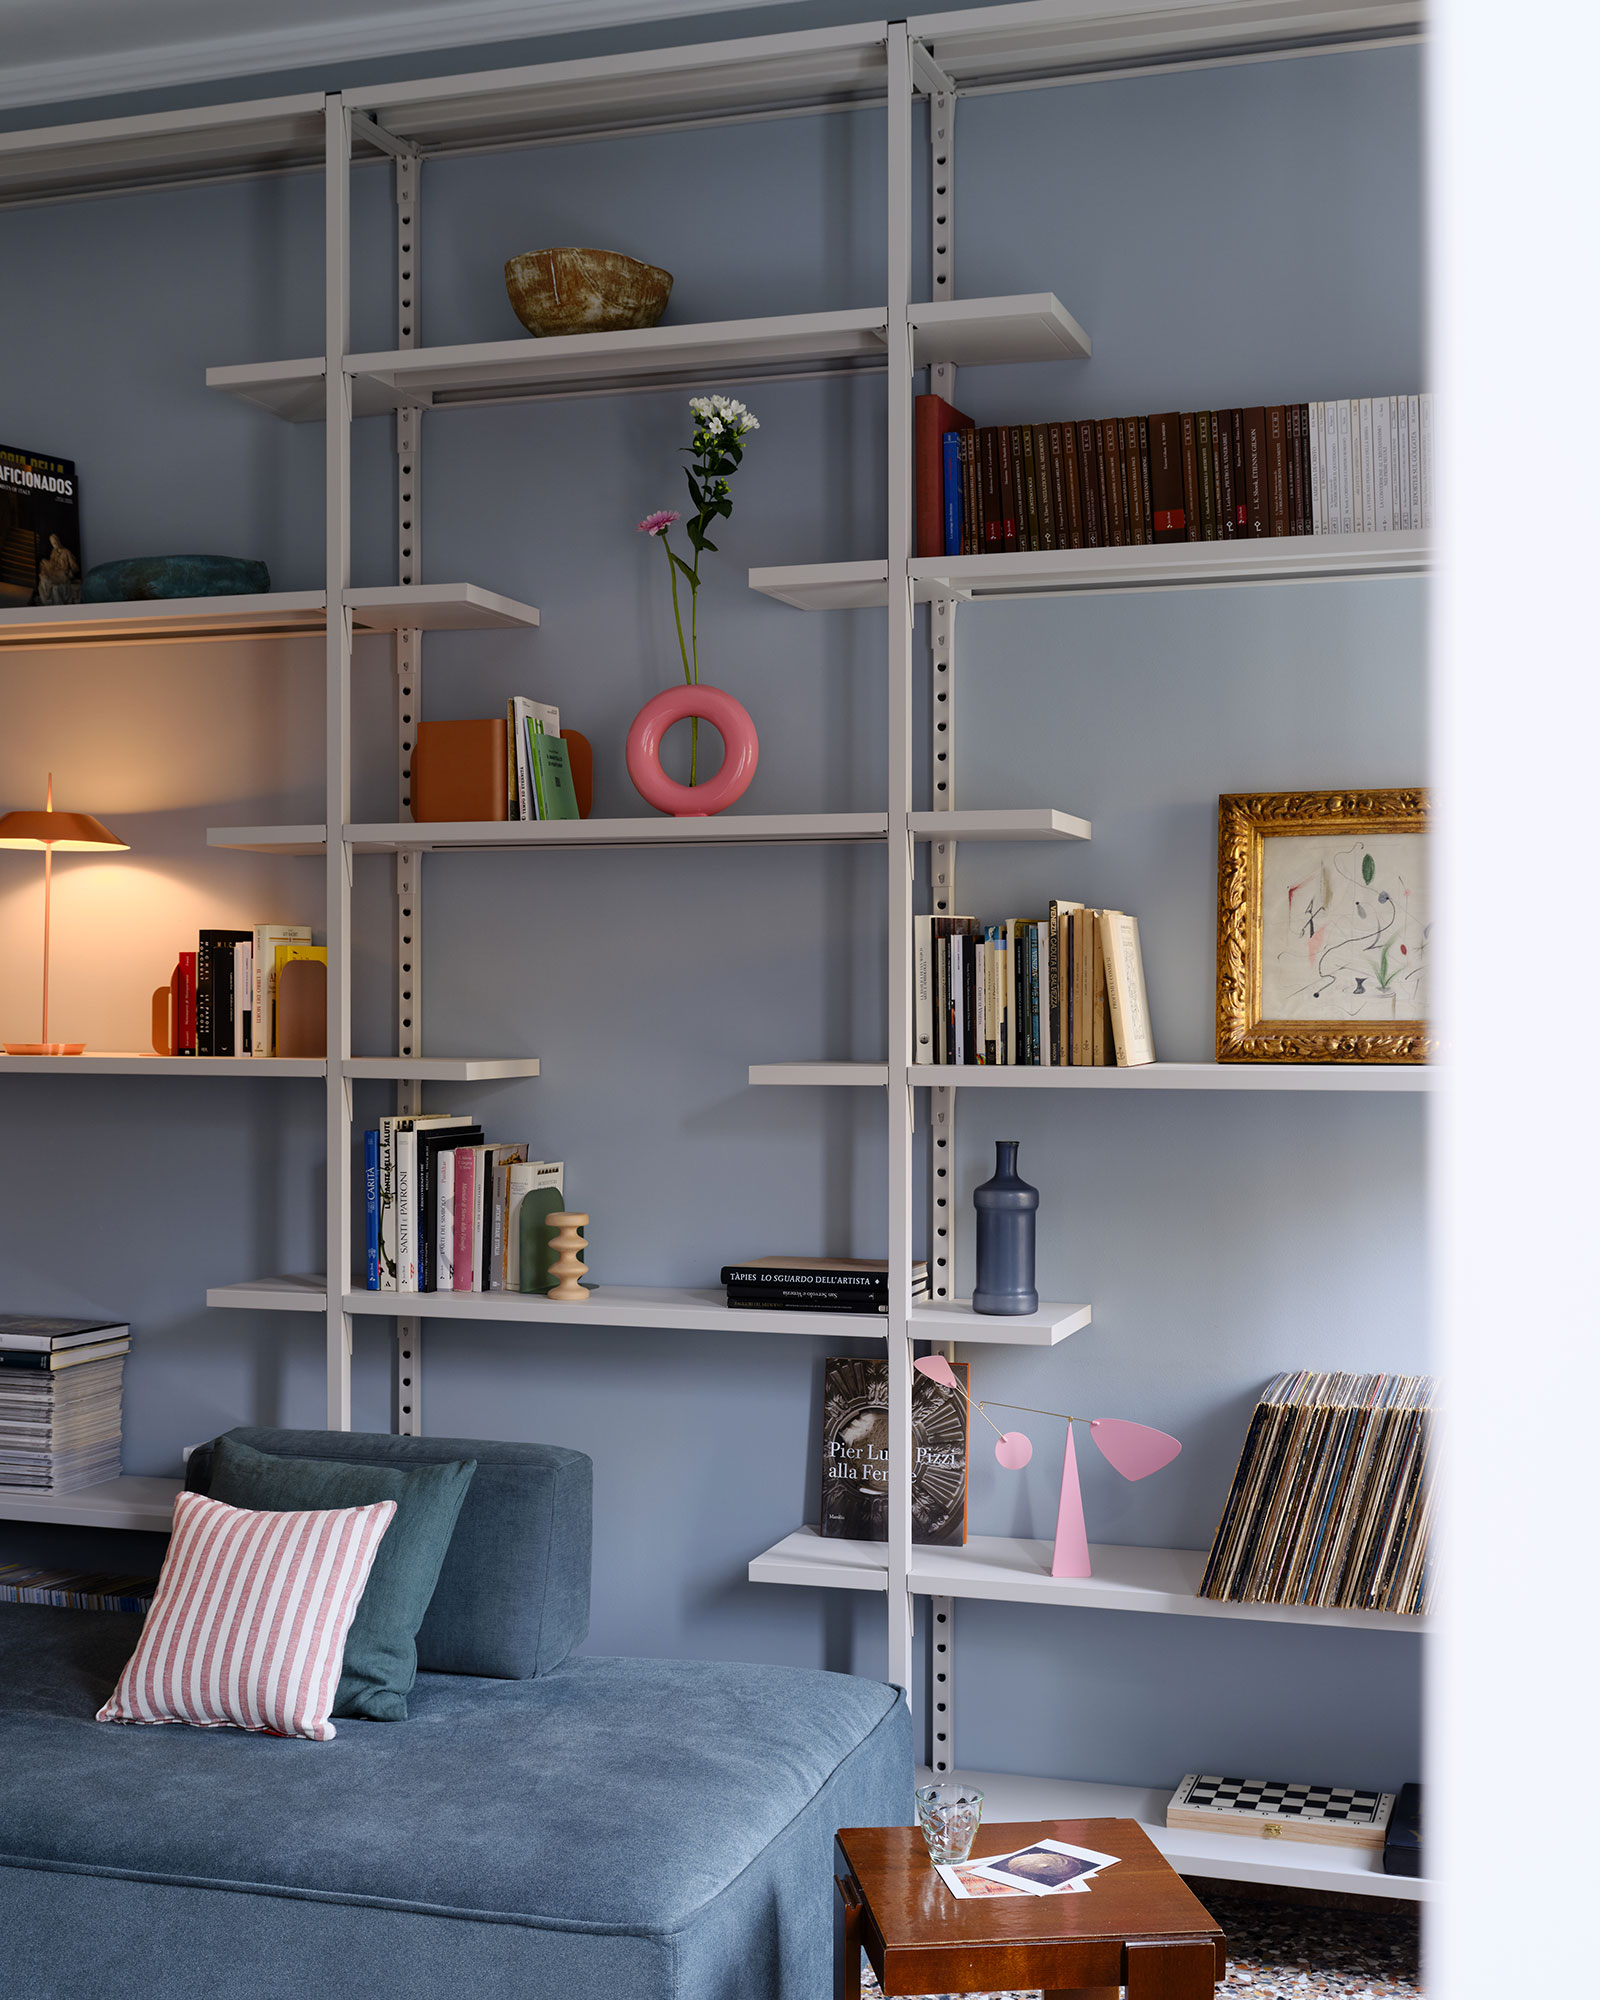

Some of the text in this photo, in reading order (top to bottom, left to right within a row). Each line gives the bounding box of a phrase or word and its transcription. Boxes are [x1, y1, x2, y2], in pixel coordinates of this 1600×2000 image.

[1249, 428, 1257, 450] GILSON
[365, 1167, 375, 1201] CARITÀ
[400, 1171, 408, 1215] PATRONI
[385, 1200, 391, 1209] LE
[730, 1273, 757, 1281] TÀPIES
[773, 1275, 813, 1284] SGUARDO
[815, 1276, 870, 1286] DELL'ARTISTA
[782, 1290, 802, 1298] Venezia
[806, 1291, 827, 1299] Servolo
[830, 1442, 863, 1459] Pier
[917, 1447, 955, 1465] Pizzi
[828, 1463, 858, 1479] alla
